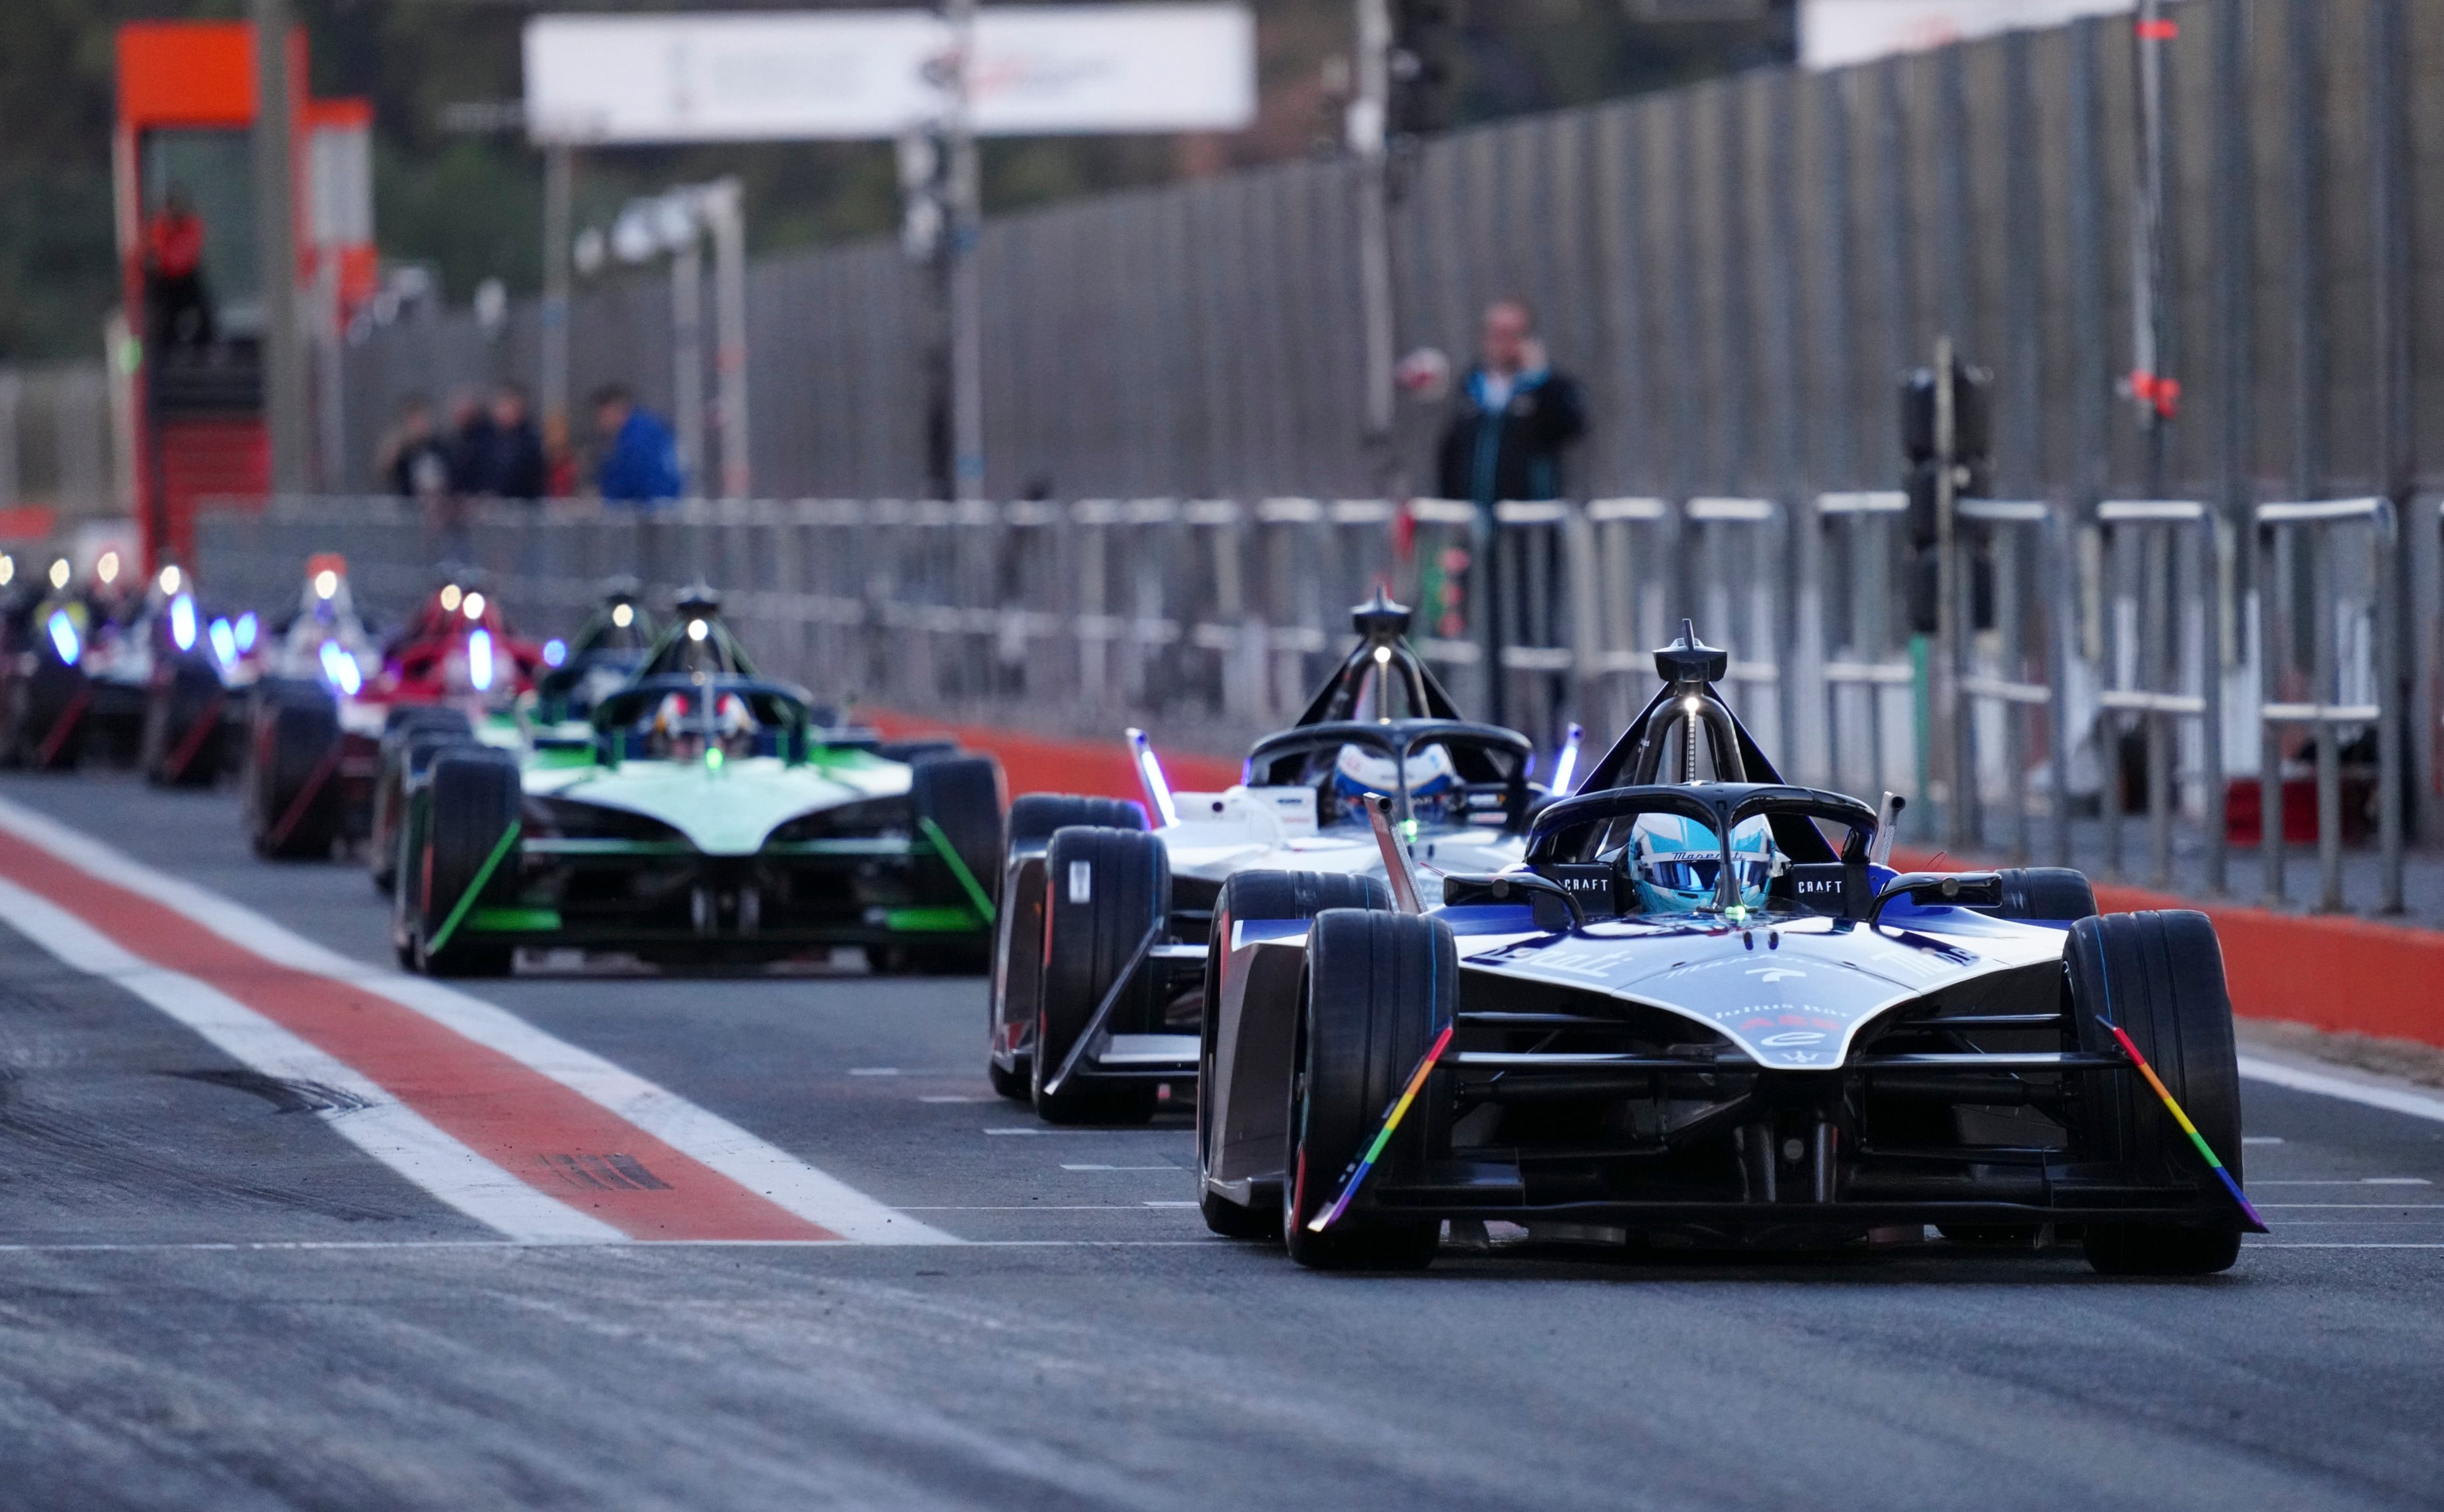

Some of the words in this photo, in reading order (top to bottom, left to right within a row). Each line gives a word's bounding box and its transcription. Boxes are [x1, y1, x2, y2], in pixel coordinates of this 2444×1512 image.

[1564, 879, 1608, 891] CRAFT
[1798, 881, 1842, 893] CRAFT
[1715, 1004, 1794, 1019] Julius
